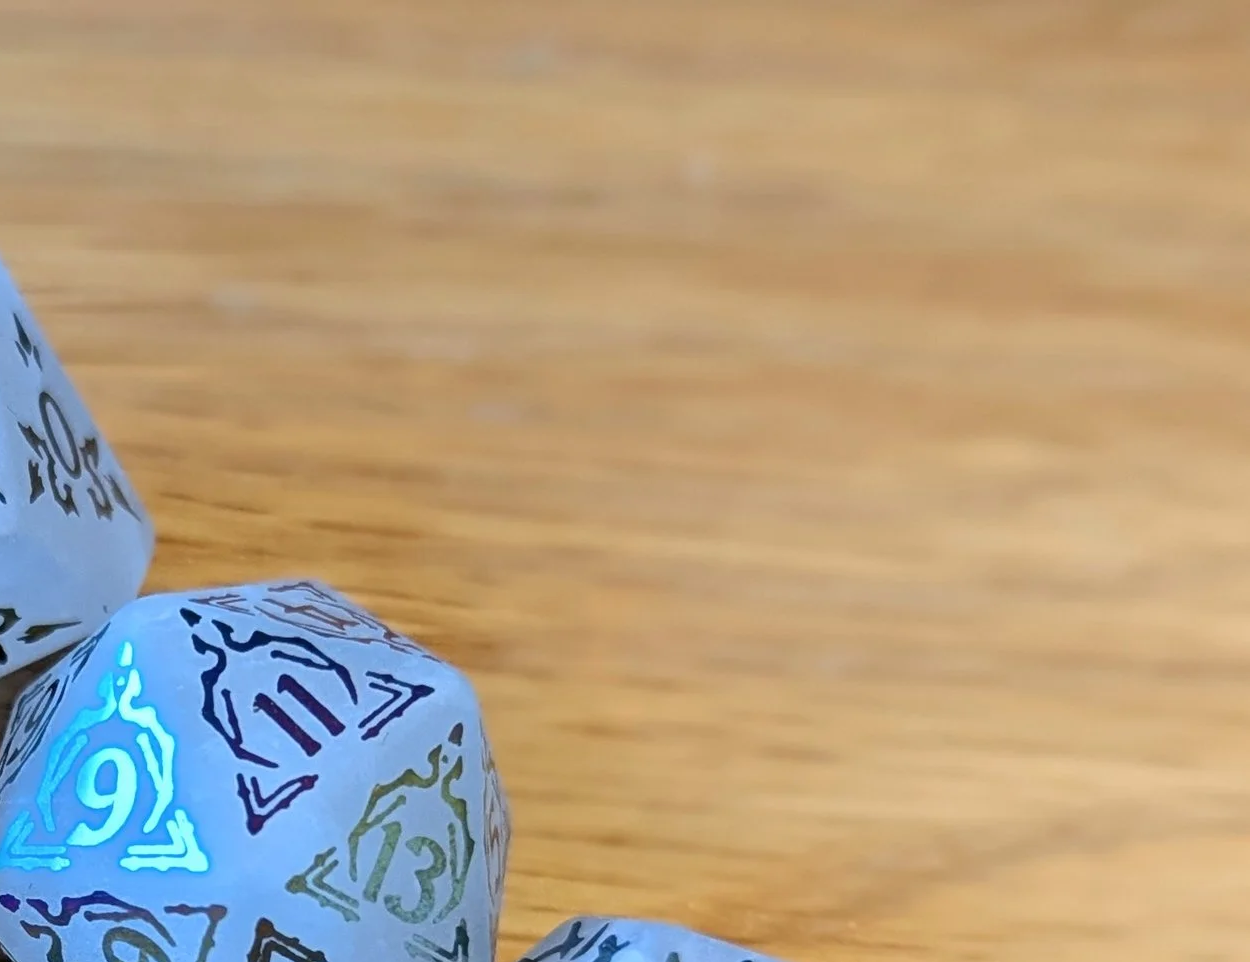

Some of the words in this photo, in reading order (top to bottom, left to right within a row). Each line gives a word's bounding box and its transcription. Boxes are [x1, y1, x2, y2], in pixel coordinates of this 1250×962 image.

[39, 391, 81, 479] 0
[254, 674, 347, 757] 11
[66, 747, 138, 846] 9
[362, 821, 448, 924] 13
